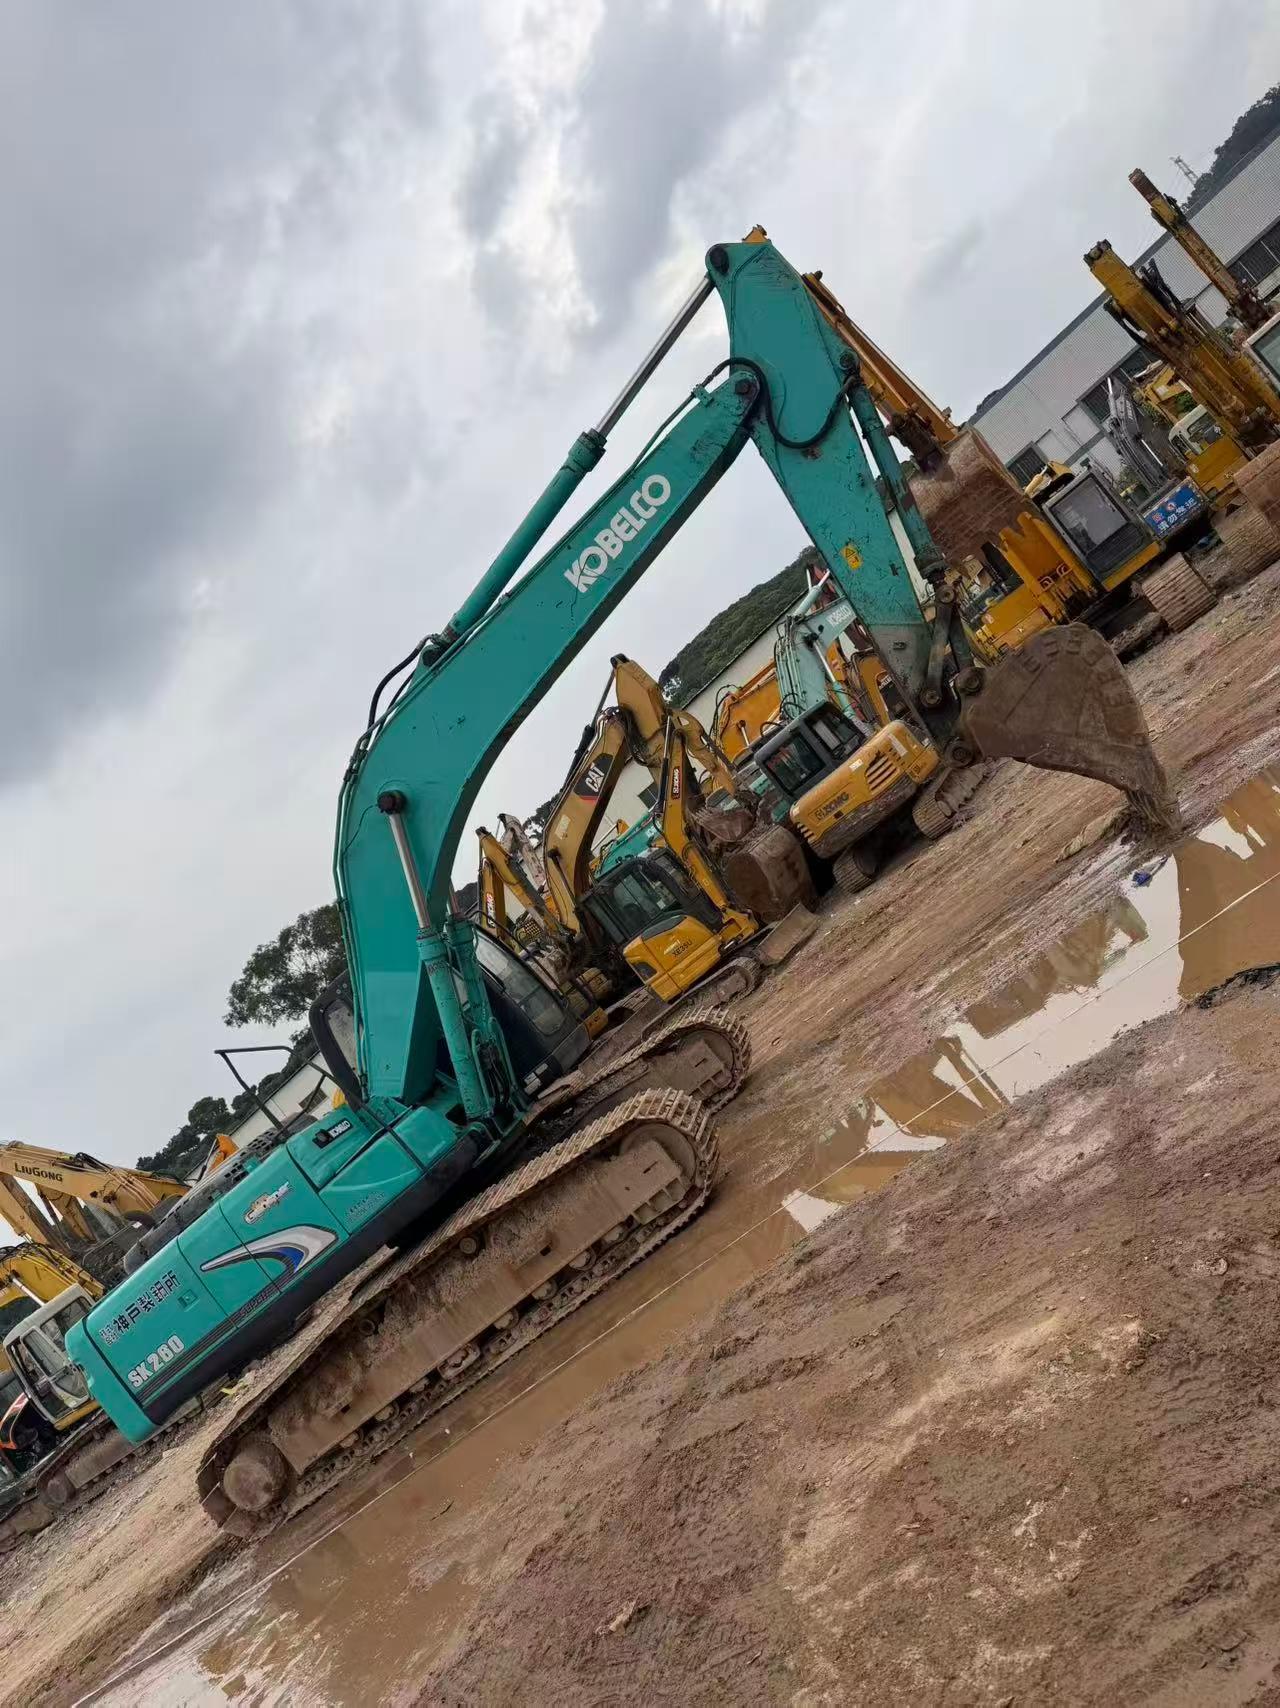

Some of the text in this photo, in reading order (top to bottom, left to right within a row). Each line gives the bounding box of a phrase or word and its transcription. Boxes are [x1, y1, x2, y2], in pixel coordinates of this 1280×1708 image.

[564, 475, 670, 592] KOBELCO
[585, 763, 605, 791] CAT
[128, 1335, 184, 1387] SK260
